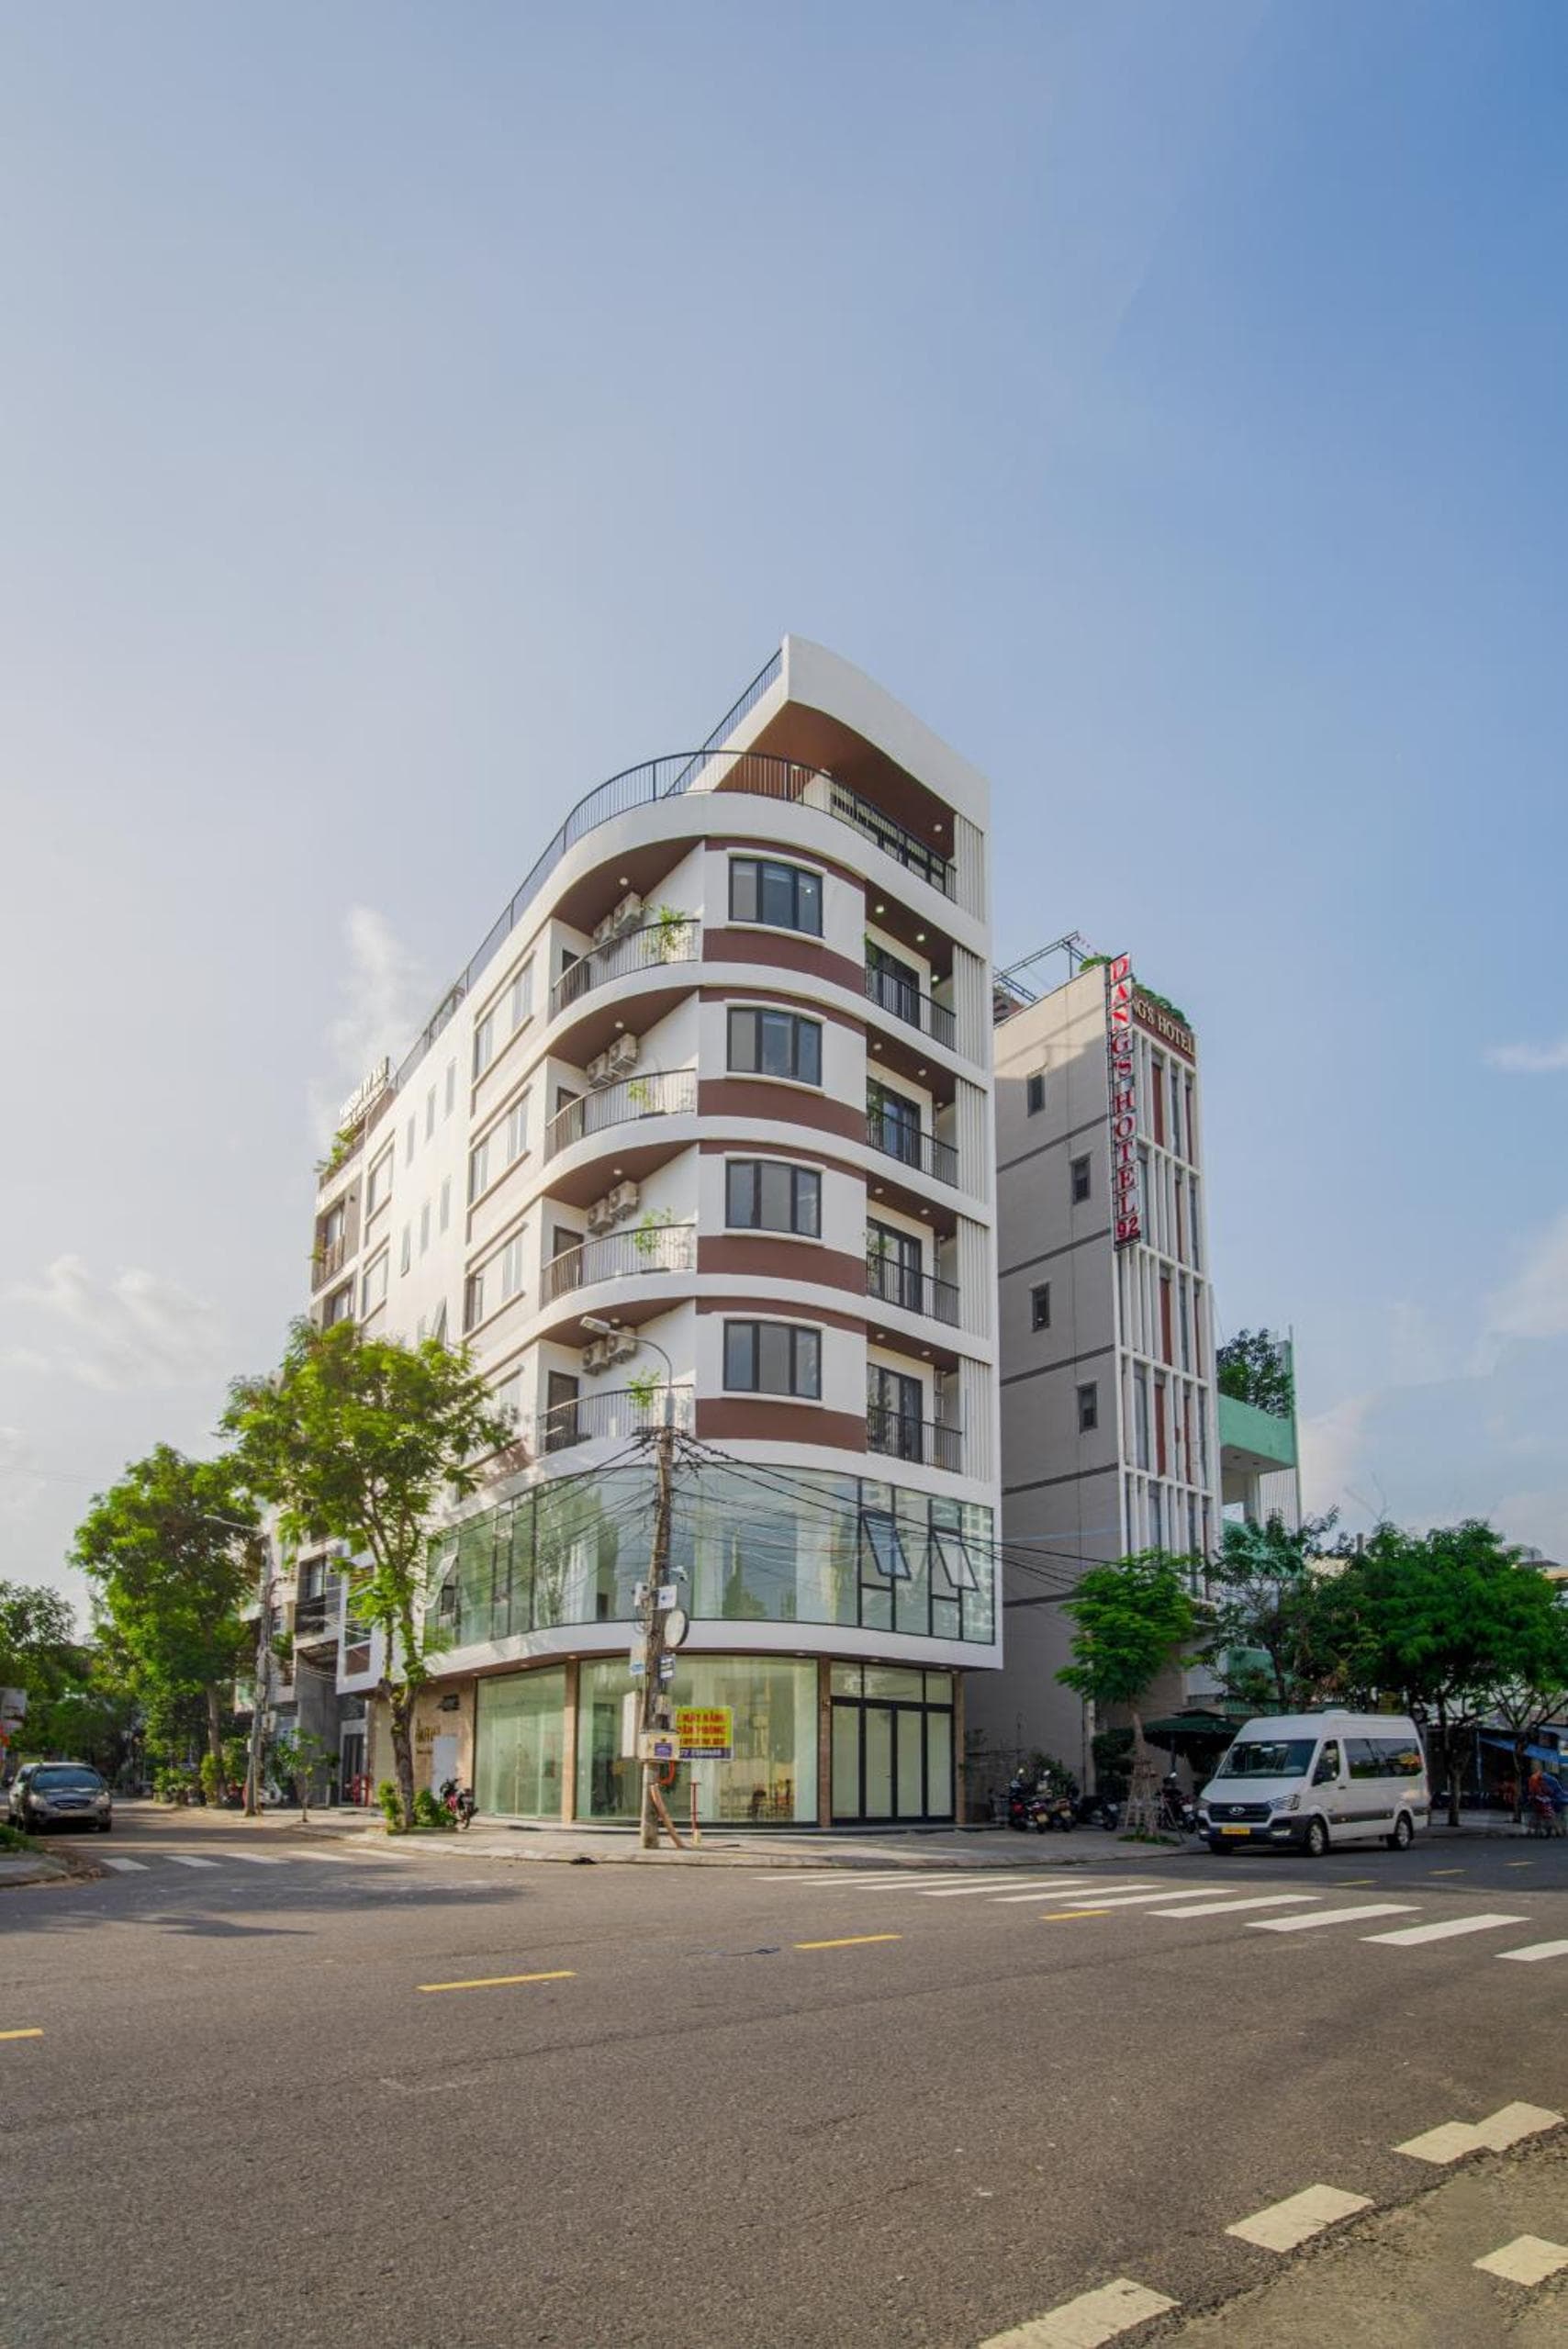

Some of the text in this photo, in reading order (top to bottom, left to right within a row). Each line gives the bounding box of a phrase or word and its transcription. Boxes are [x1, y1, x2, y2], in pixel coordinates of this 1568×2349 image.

[1157, 1013, 1195, 1057] HOTEL
[1114, 1090, 1135, 1215] HOTEL
[1116, 1215, 1138, 1238] 92
